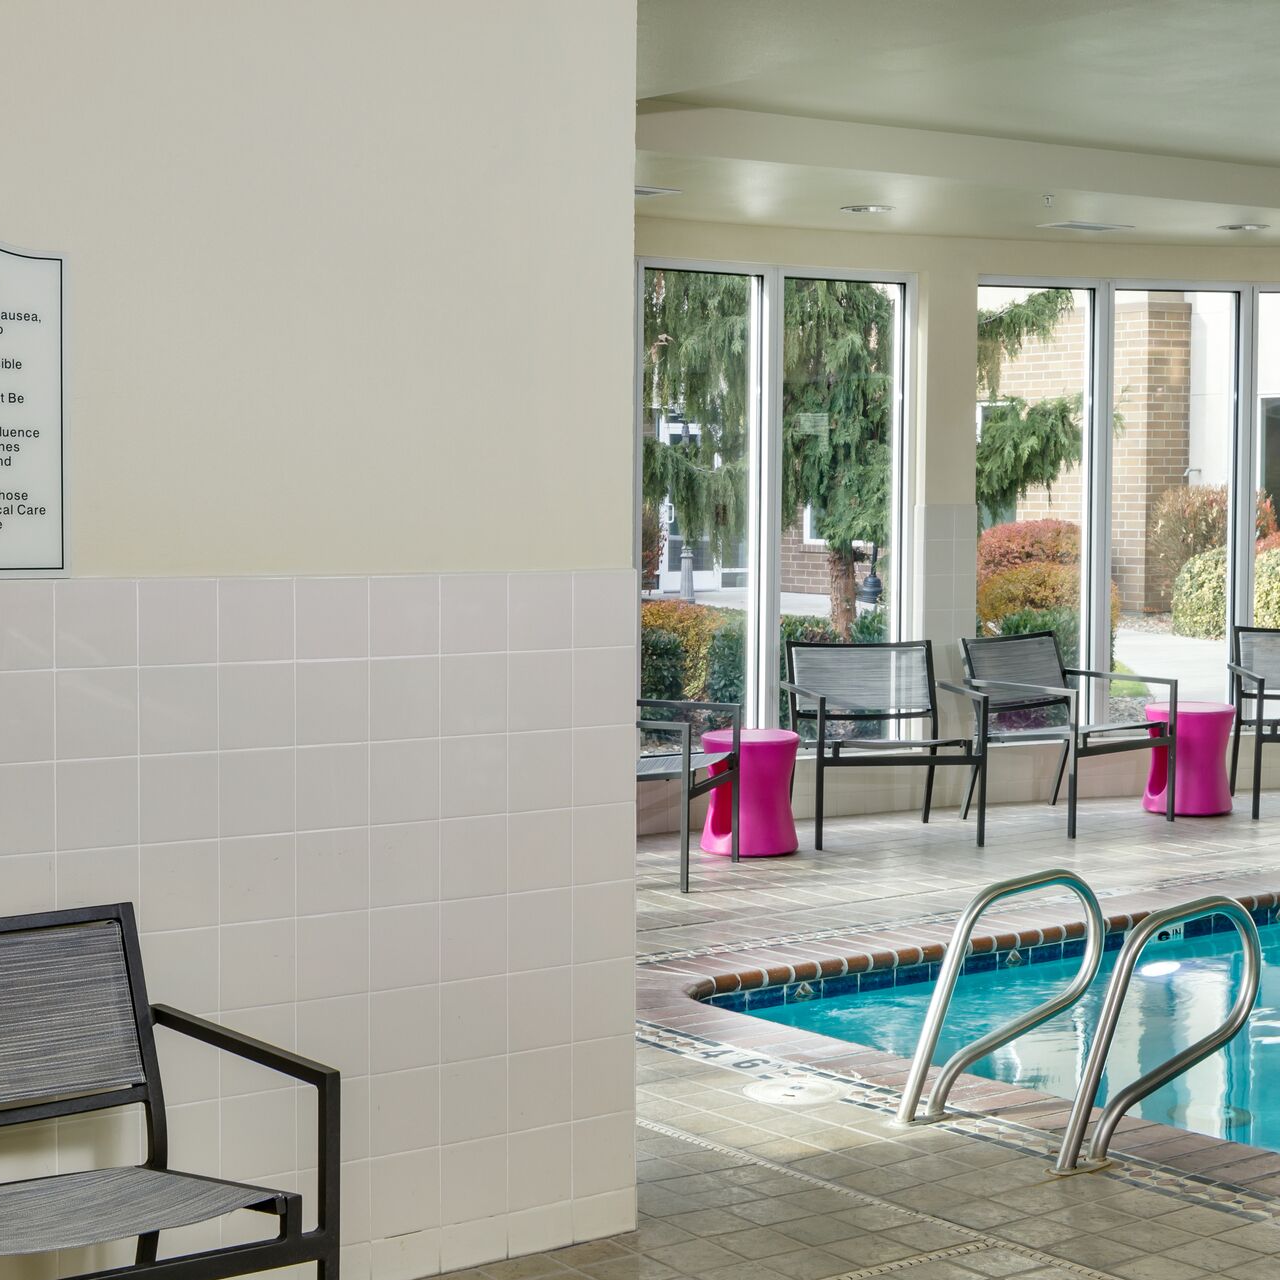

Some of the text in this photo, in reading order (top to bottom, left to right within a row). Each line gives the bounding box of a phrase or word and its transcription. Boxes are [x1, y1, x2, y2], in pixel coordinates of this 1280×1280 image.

[8, 392, 24, 404] Be
[17, 504, 46, 515] Care
[700, 1049, 735, 1059] 4
[732, 1058, 771, 1069] 6
